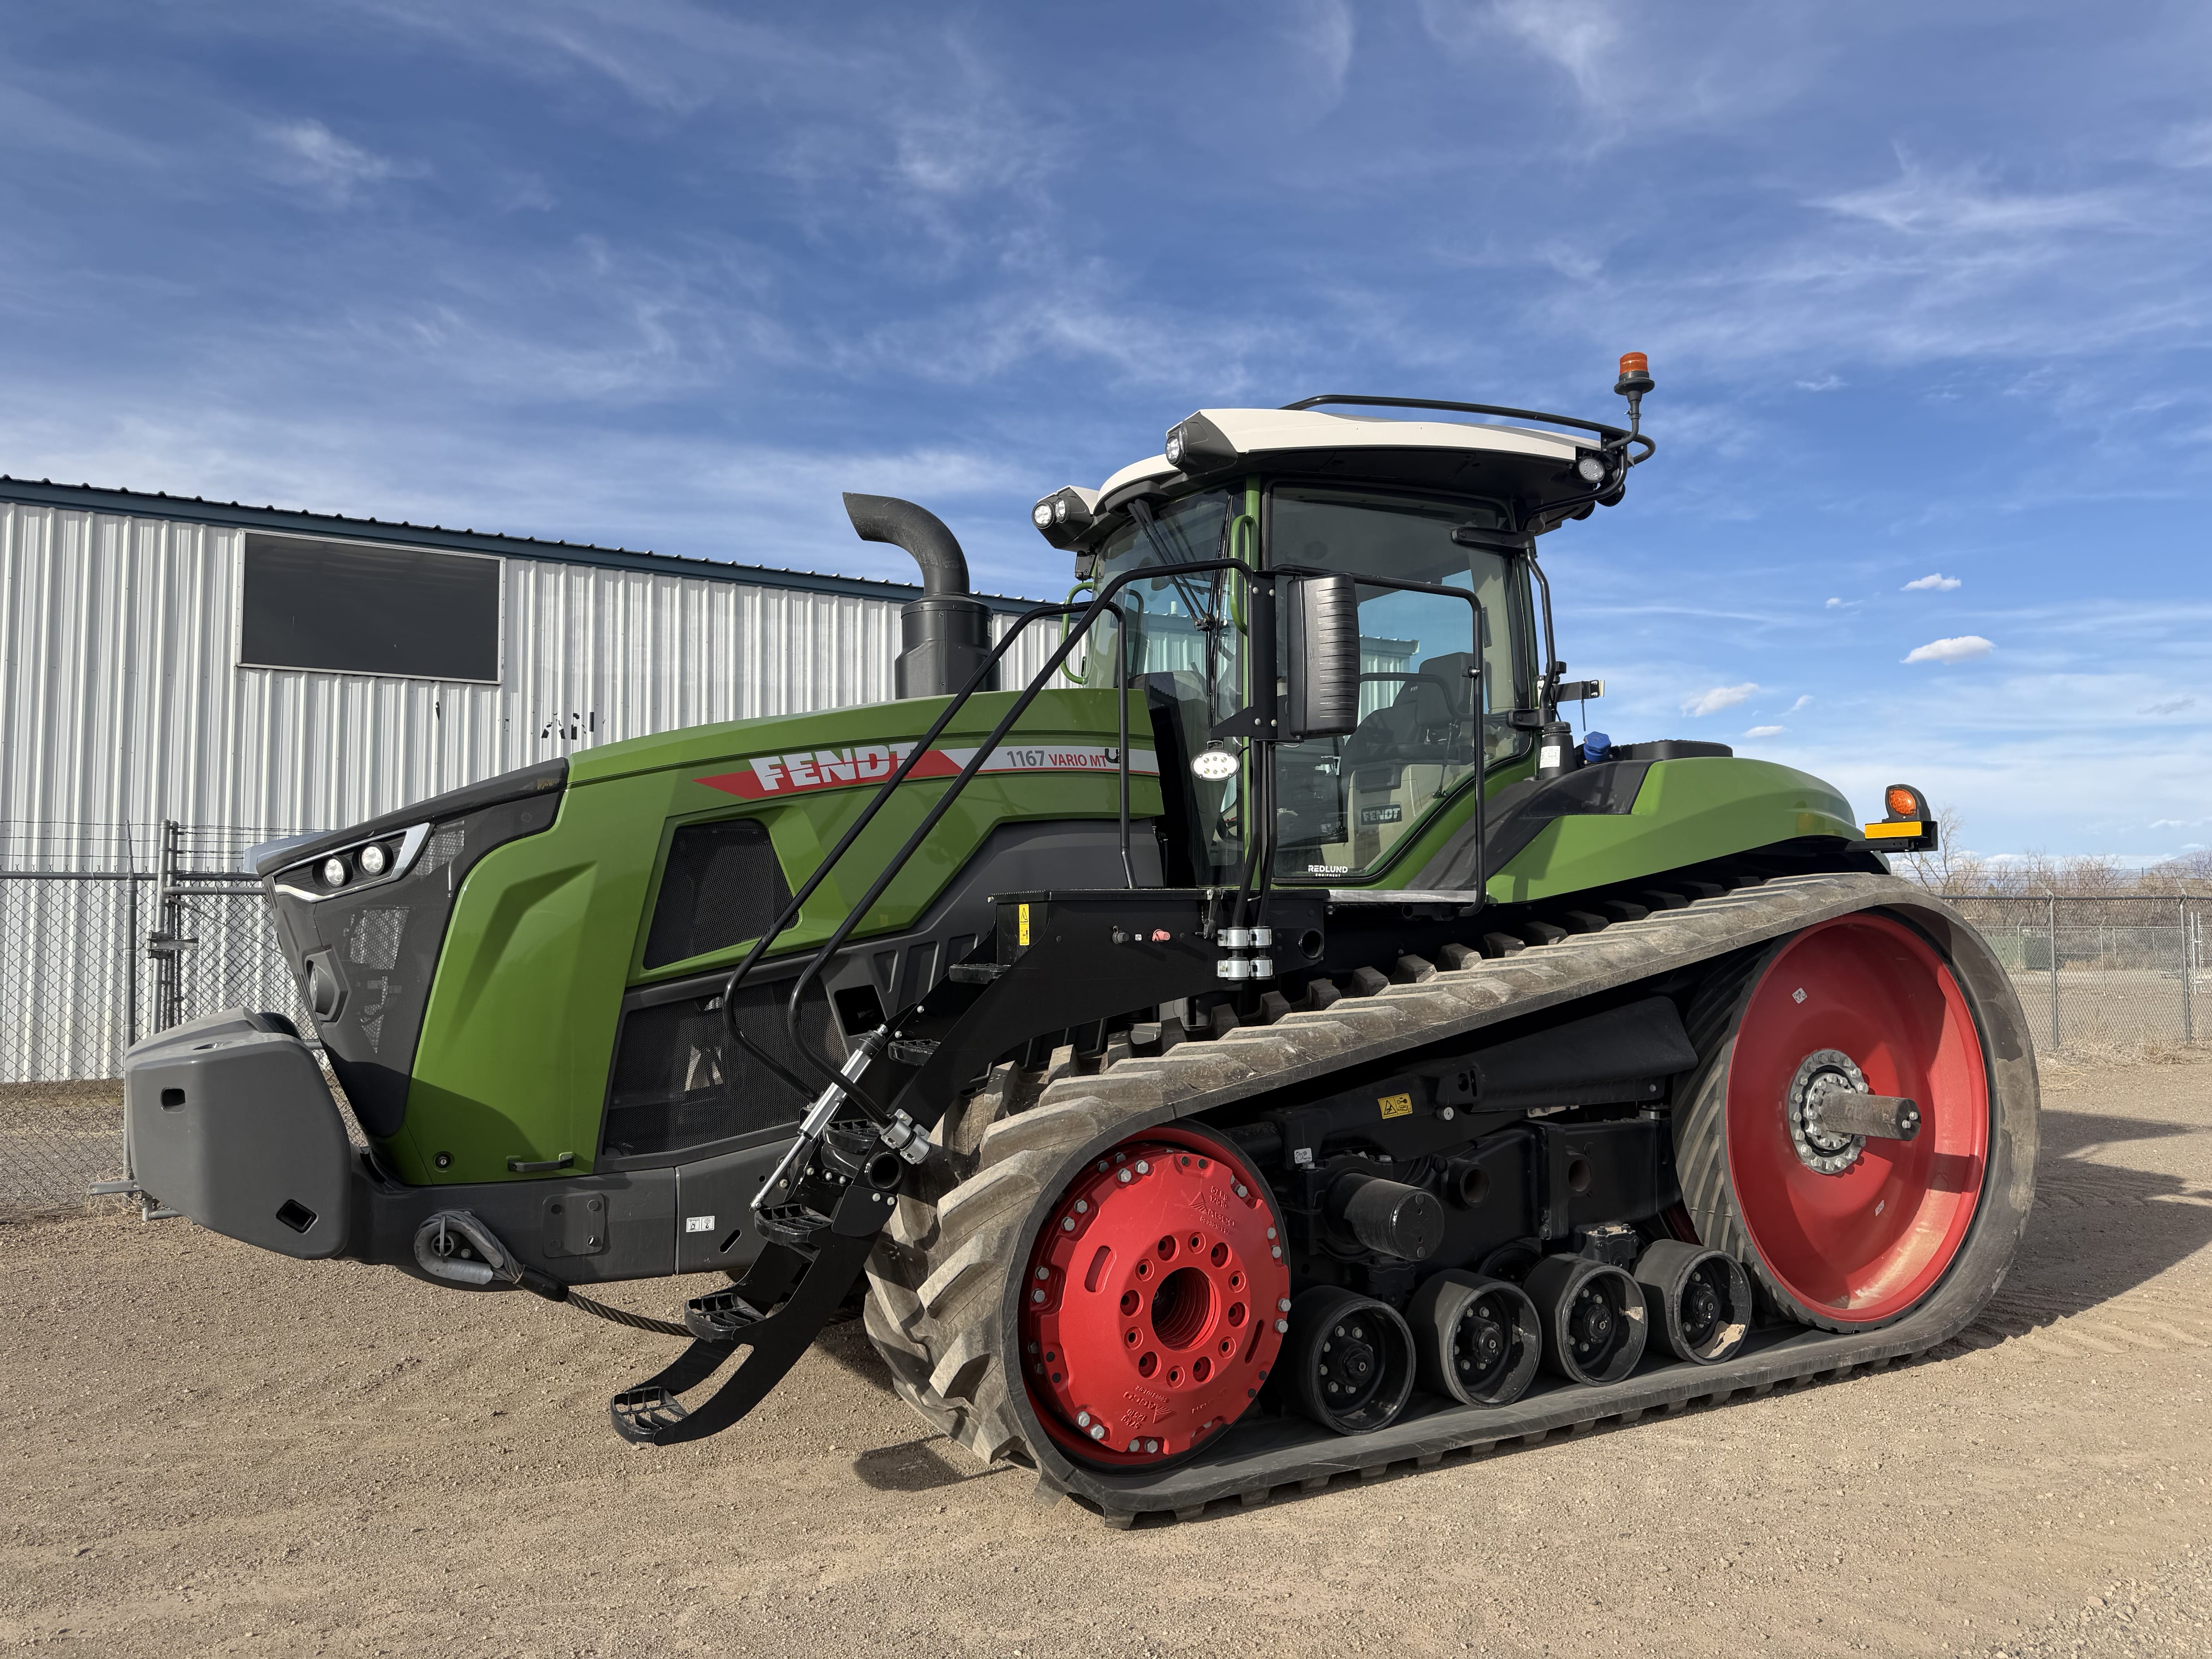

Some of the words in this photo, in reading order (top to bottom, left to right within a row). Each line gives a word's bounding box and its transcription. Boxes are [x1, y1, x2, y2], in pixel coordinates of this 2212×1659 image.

[1007, 750, 1045, 767] 1167
[1048, 754, 1087, 766] VARIO
[1089, 754, 1107, 767] MT
[749, 742, 918, 791] FENDT
[1362, 807, 1400, 821] FENDT
[1308, 865, 1348, 873] REDLUND
